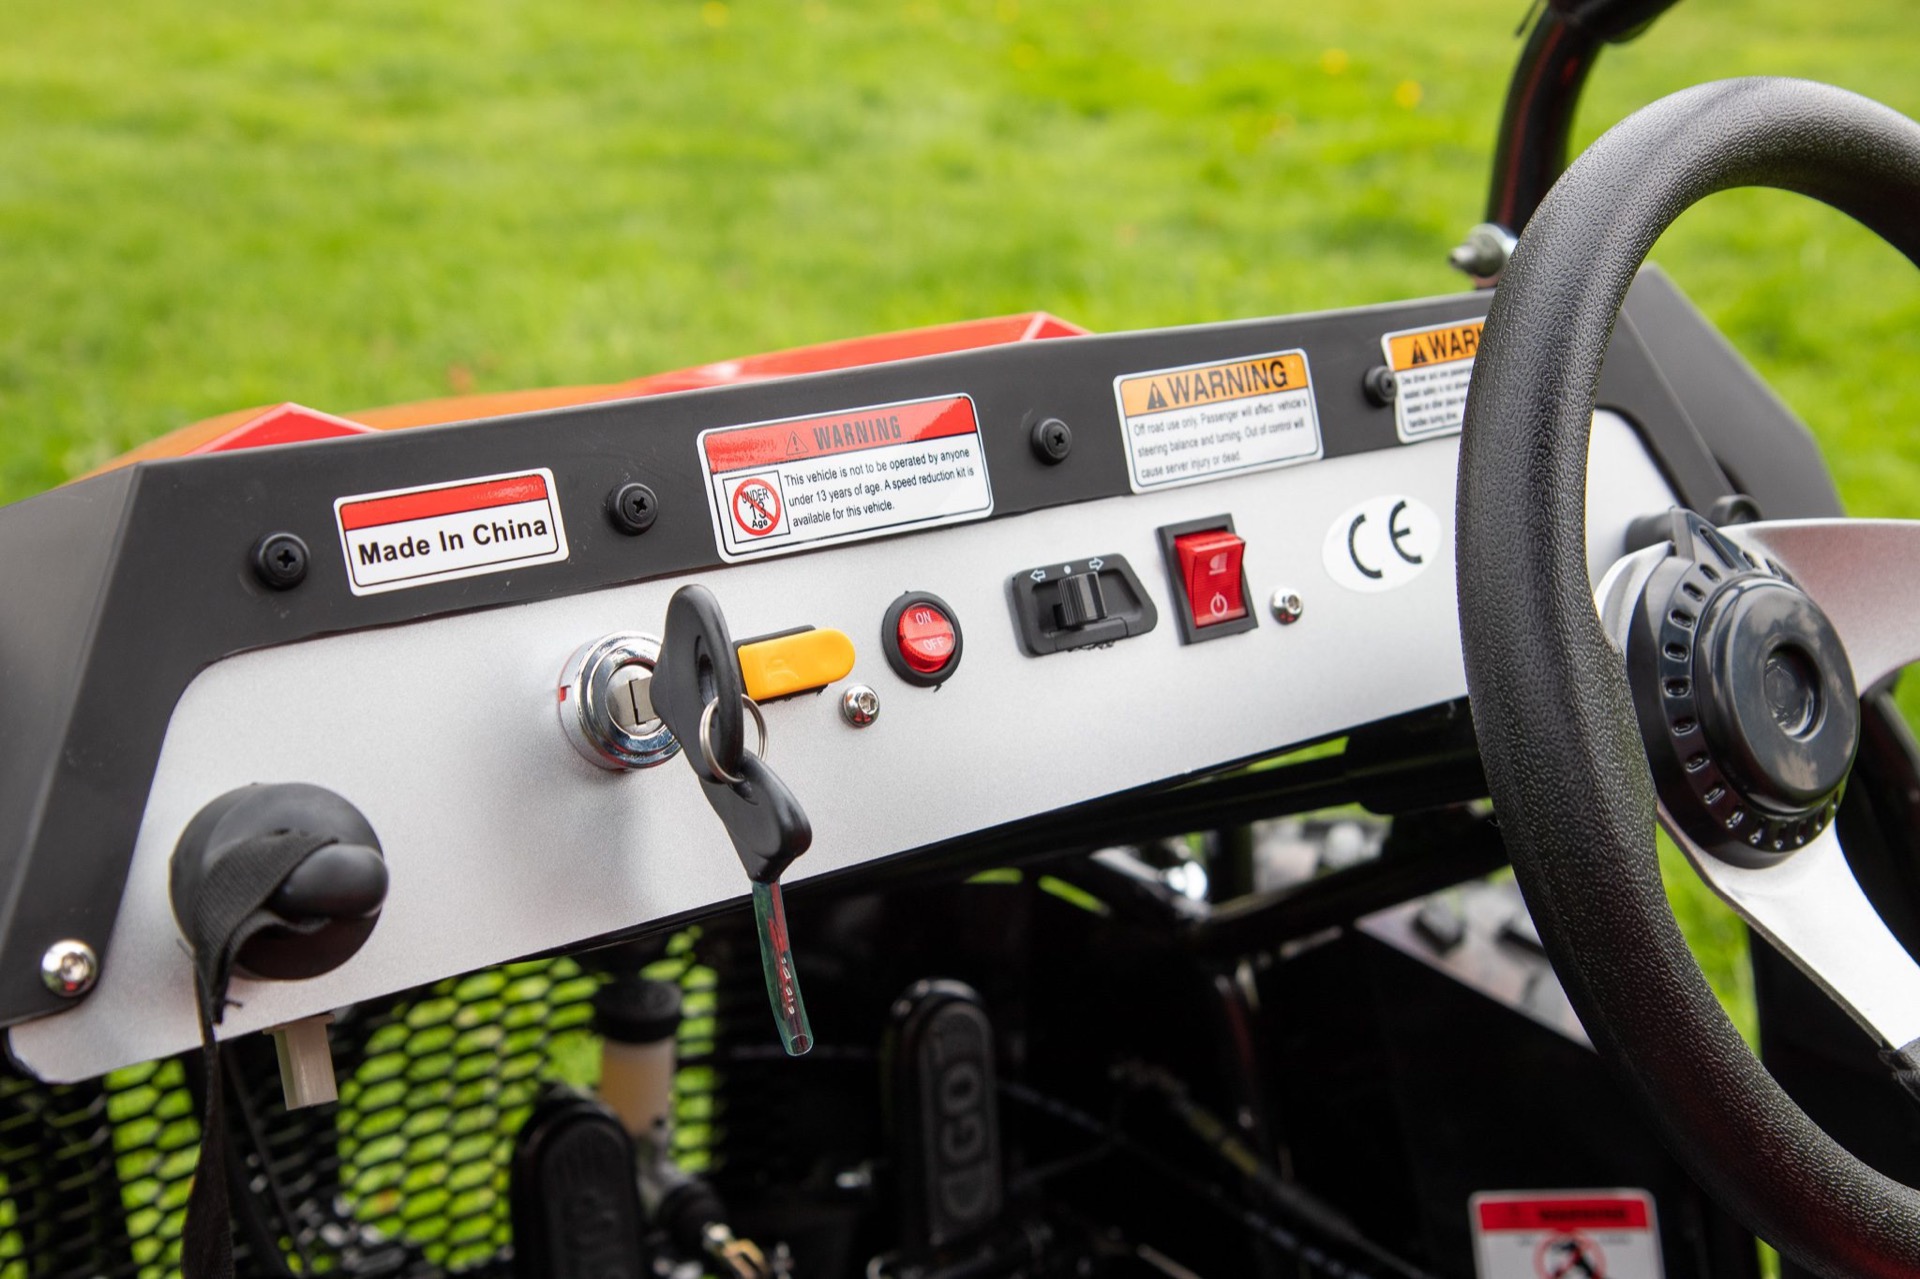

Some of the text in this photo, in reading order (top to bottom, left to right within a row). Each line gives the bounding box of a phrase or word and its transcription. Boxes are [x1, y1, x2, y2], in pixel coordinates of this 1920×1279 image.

[1166, 360, 1288, 405] WARNING
[813, 415, 902, 450] WARNING
[1134, 423, 1145, 436] Off
[1147, 422, 1164, 433] road
[1167, 420, 1180, 431] use
[1201, 411, 1238, 425] Passenger
[1241, 405, 1252, 417] will
[1138, 443, 1168, 458] steering
[1169, 438, 1198, 452] balance
[1201, 434, 1215, 446] and
[1244, 426, 1258, 438] Out
[1260, 423, 1267, 435] of
[1268, 421, 1292, 433] control
[1294, 417, 1304, 428] will
[784, 448, 970, 487] This vehicle is not to be operated by anyone
[1141, 465, 1163, 479] cause
[1165, 461, 1189, 474] server
[1190, 457, 1211, 471] injury
[1213, 455, 1220, 465] or
[741, 488, 770, 504] UNDER
[789, 465, 975, 507] under 13 years of age. A speed reduction kit is
[750, 502, 767, 520] 13
[752, 519, 768, 529] Age
[793, 499, 895, 528] available for this vehicle.
[358, 519, 547, 566] Made In China
[1348, 500, 1423, 579] CE
[915, 610, 932, 625] ON
[923, 636, 945, 651] OFF
